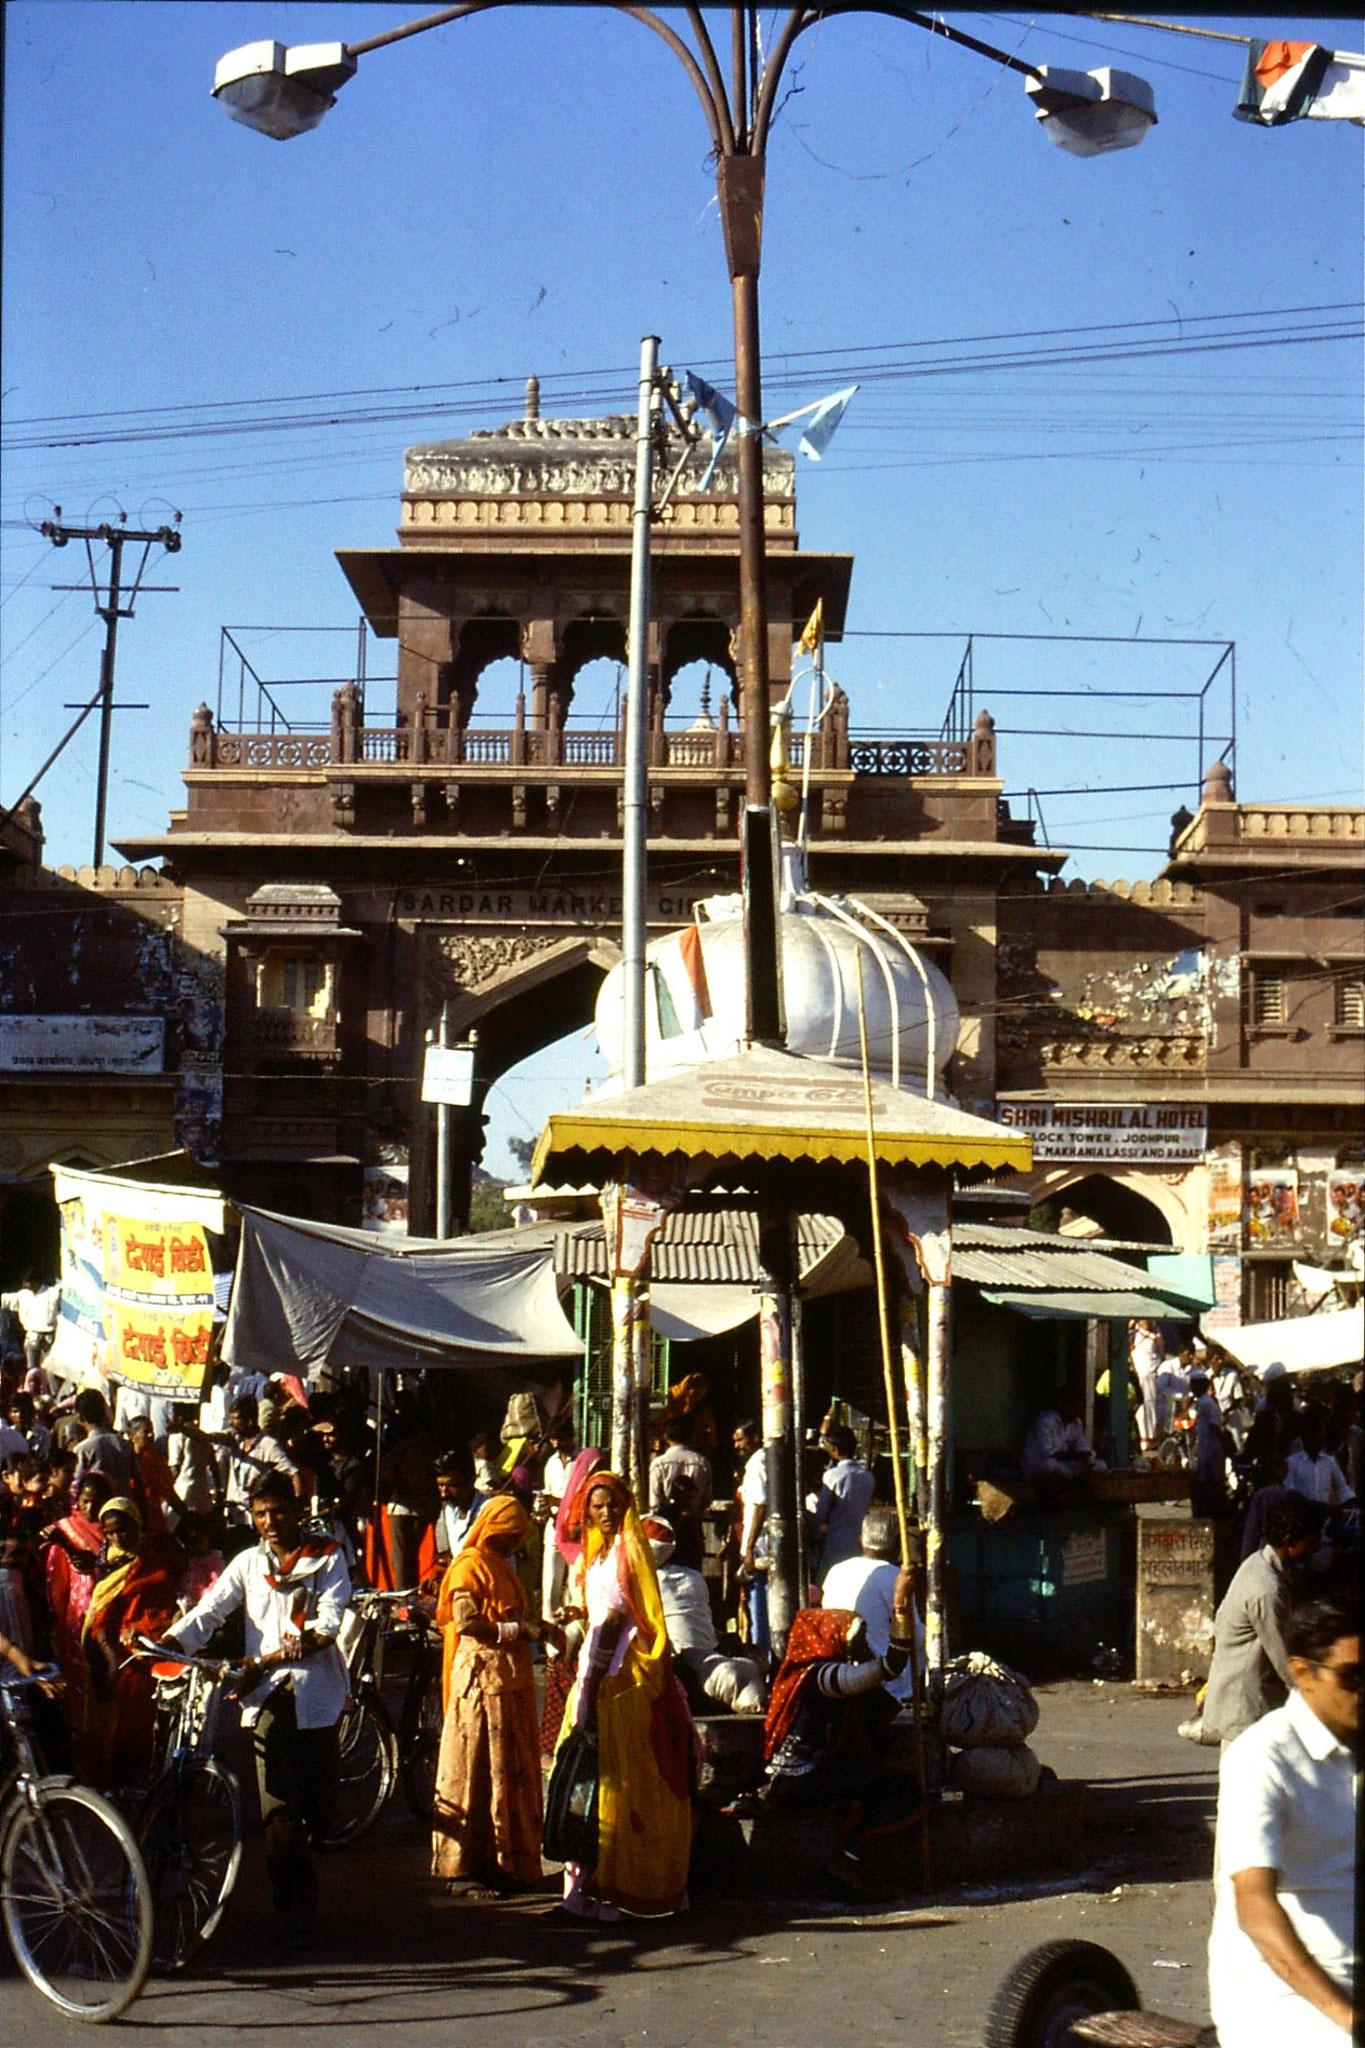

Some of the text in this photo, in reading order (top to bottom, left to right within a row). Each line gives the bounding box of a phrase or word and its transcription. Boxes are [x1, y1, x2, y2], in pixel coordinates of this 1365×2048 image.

[403, 894, 512, 914] SARDAR
[529, 895, 624, 916] MARKE
[1001, 1108, 1205, 1128] SHRI MISHRILAL HOTEL
[1121, 1133, 1180, 1143] JODHPUR
[1141, 1149, 1165, 1158] AND
